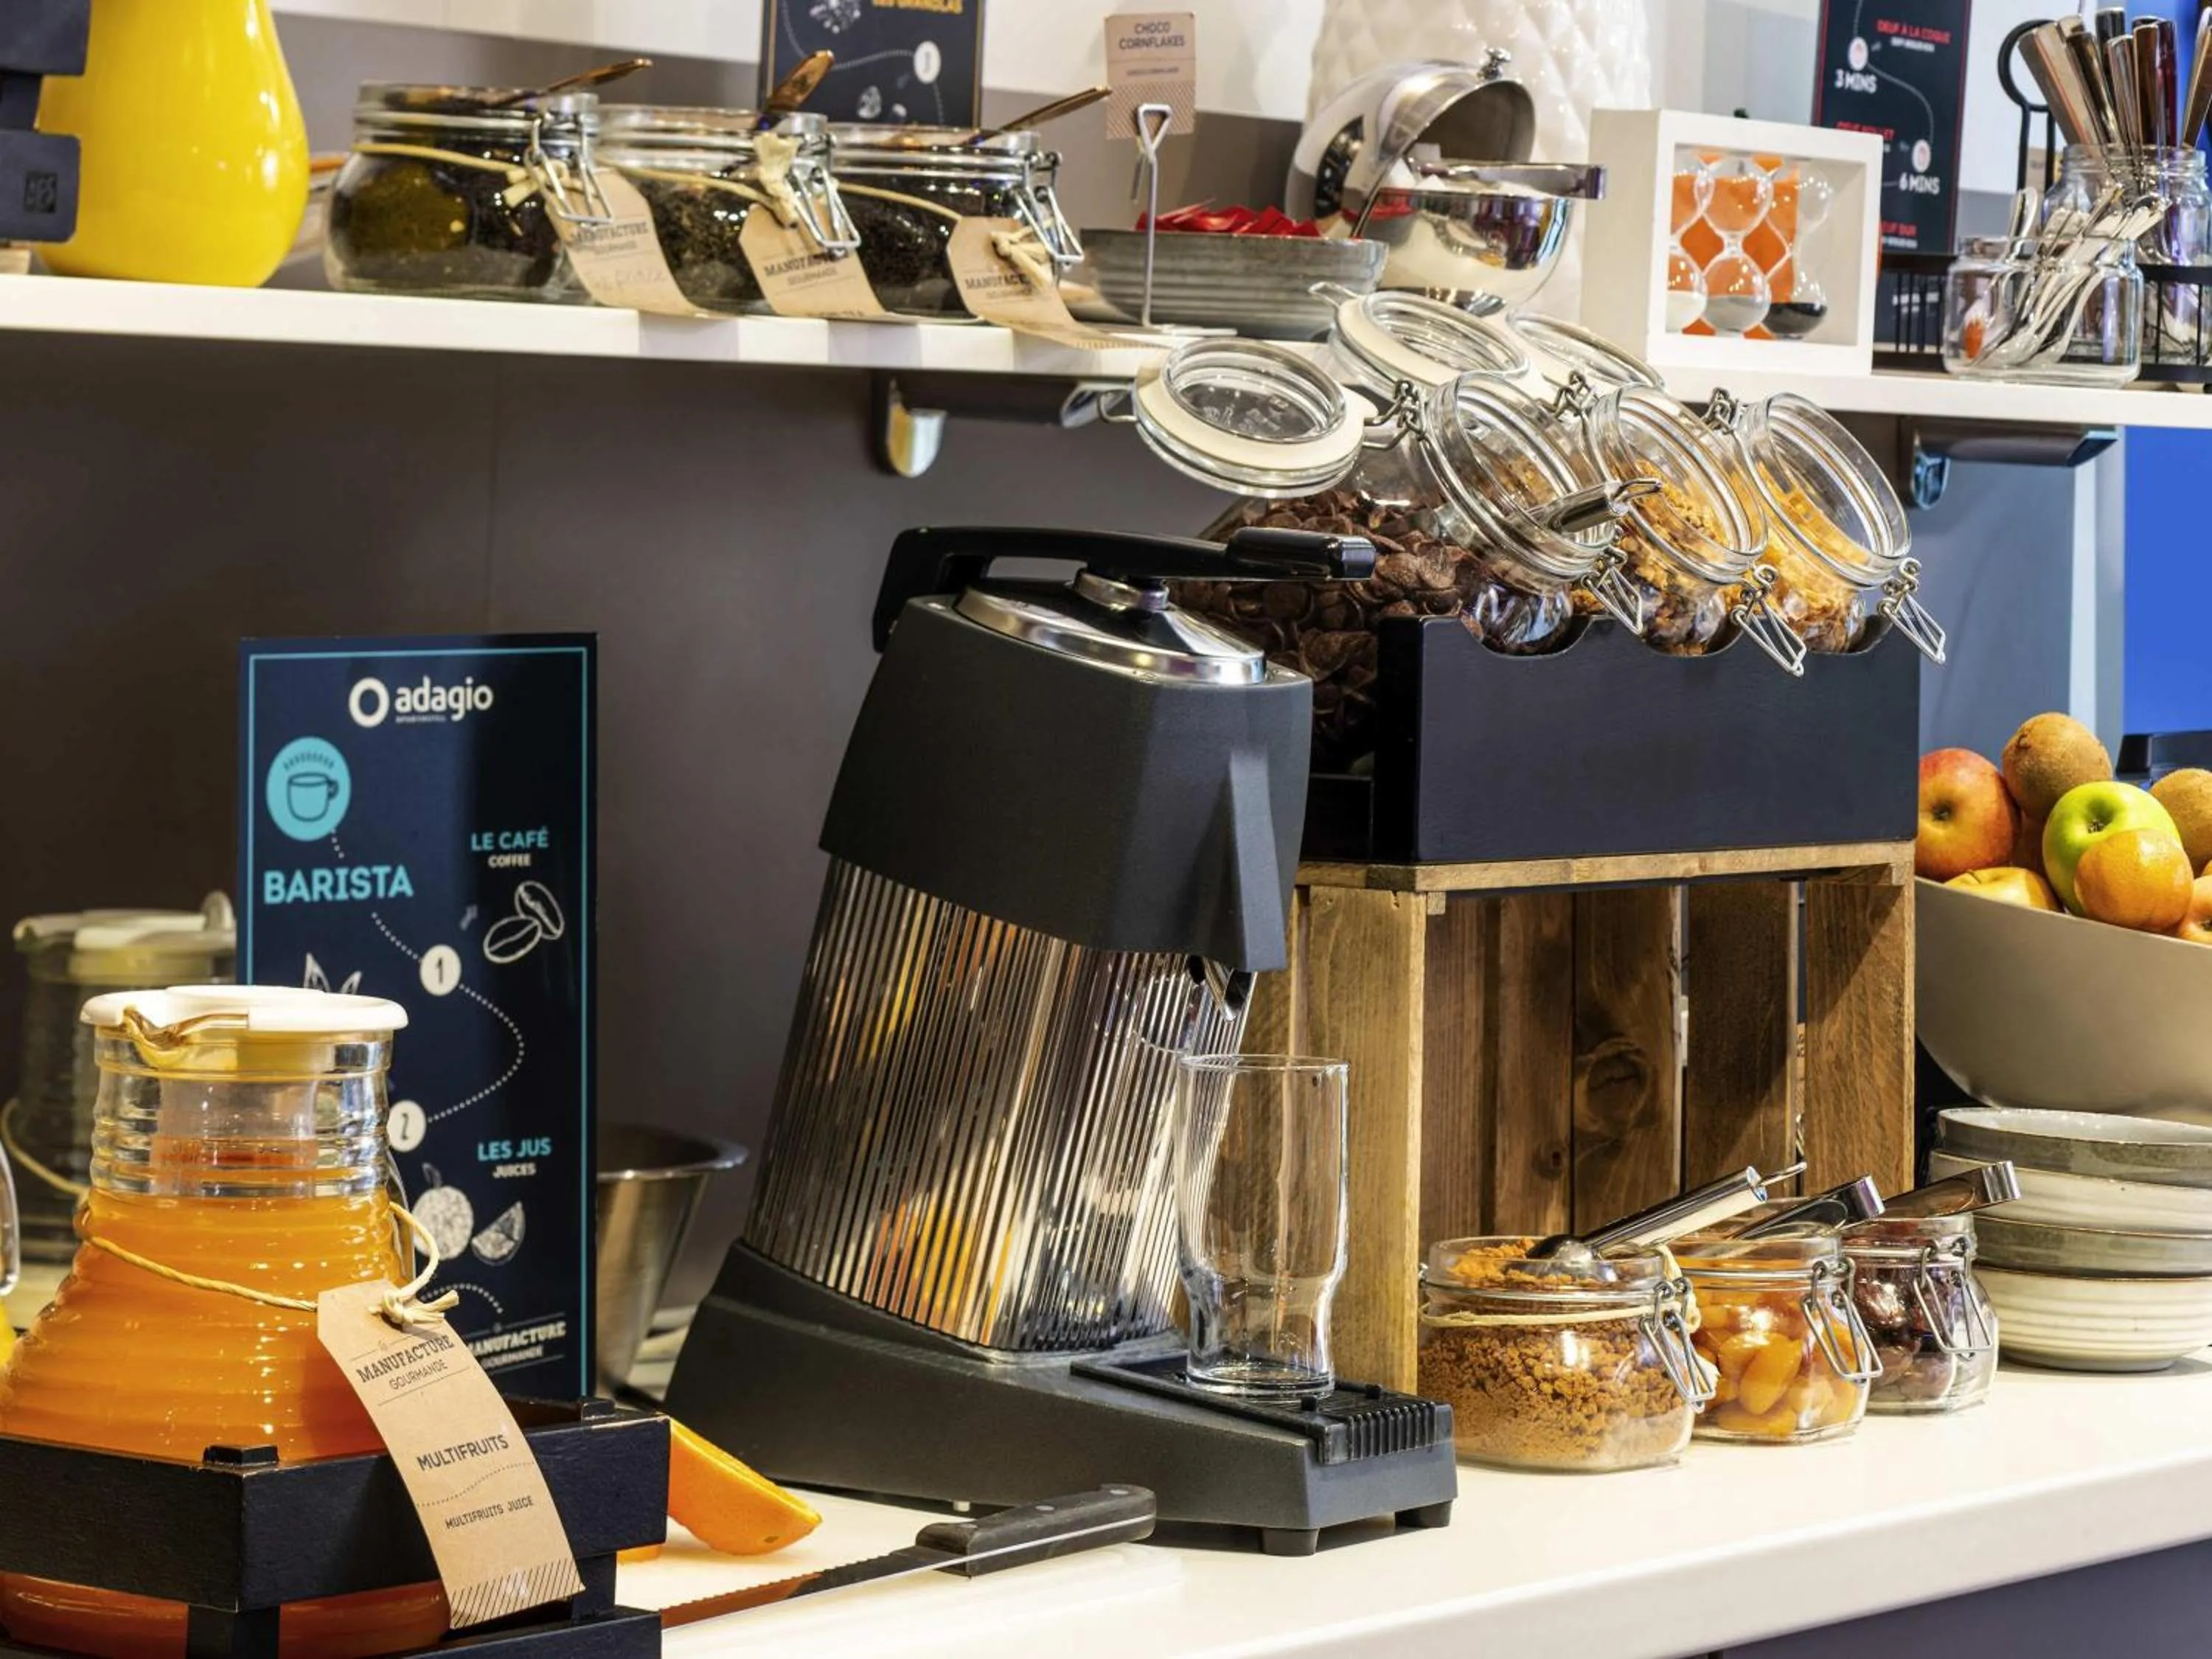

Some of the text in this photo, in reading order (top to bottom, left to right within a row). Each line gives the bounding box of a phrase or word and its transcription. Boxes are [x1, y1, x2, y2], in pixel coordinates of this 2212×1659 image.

[1134, 21, 1170, 34] CHOCO
[1119, 35, 1185, 49] CORNFLAKES
[1834, 69, 1877, 94] 3 MINS
[1899, 172, 1941, 195] 6 MINS
[394, 675, 494, 722] adagio
[470, 825, 550, 852] LE CAFÉ
[487, 853, 532, 869] COFFEE
[263, 864, 414, 905] BARISTA
[477, 1136, 552, 1162] LES JUS
[493, 1163, 537, 1179] JUICES
[356, 1334, 456, 1383] MANUFACTURE
[389, 1359, 448, 1390] GOURMANDE
[417, 1434, 509, 1471] MULTIFRUITS
[444, 1495, 535, 1530] MULTIFRUITS JUICE
